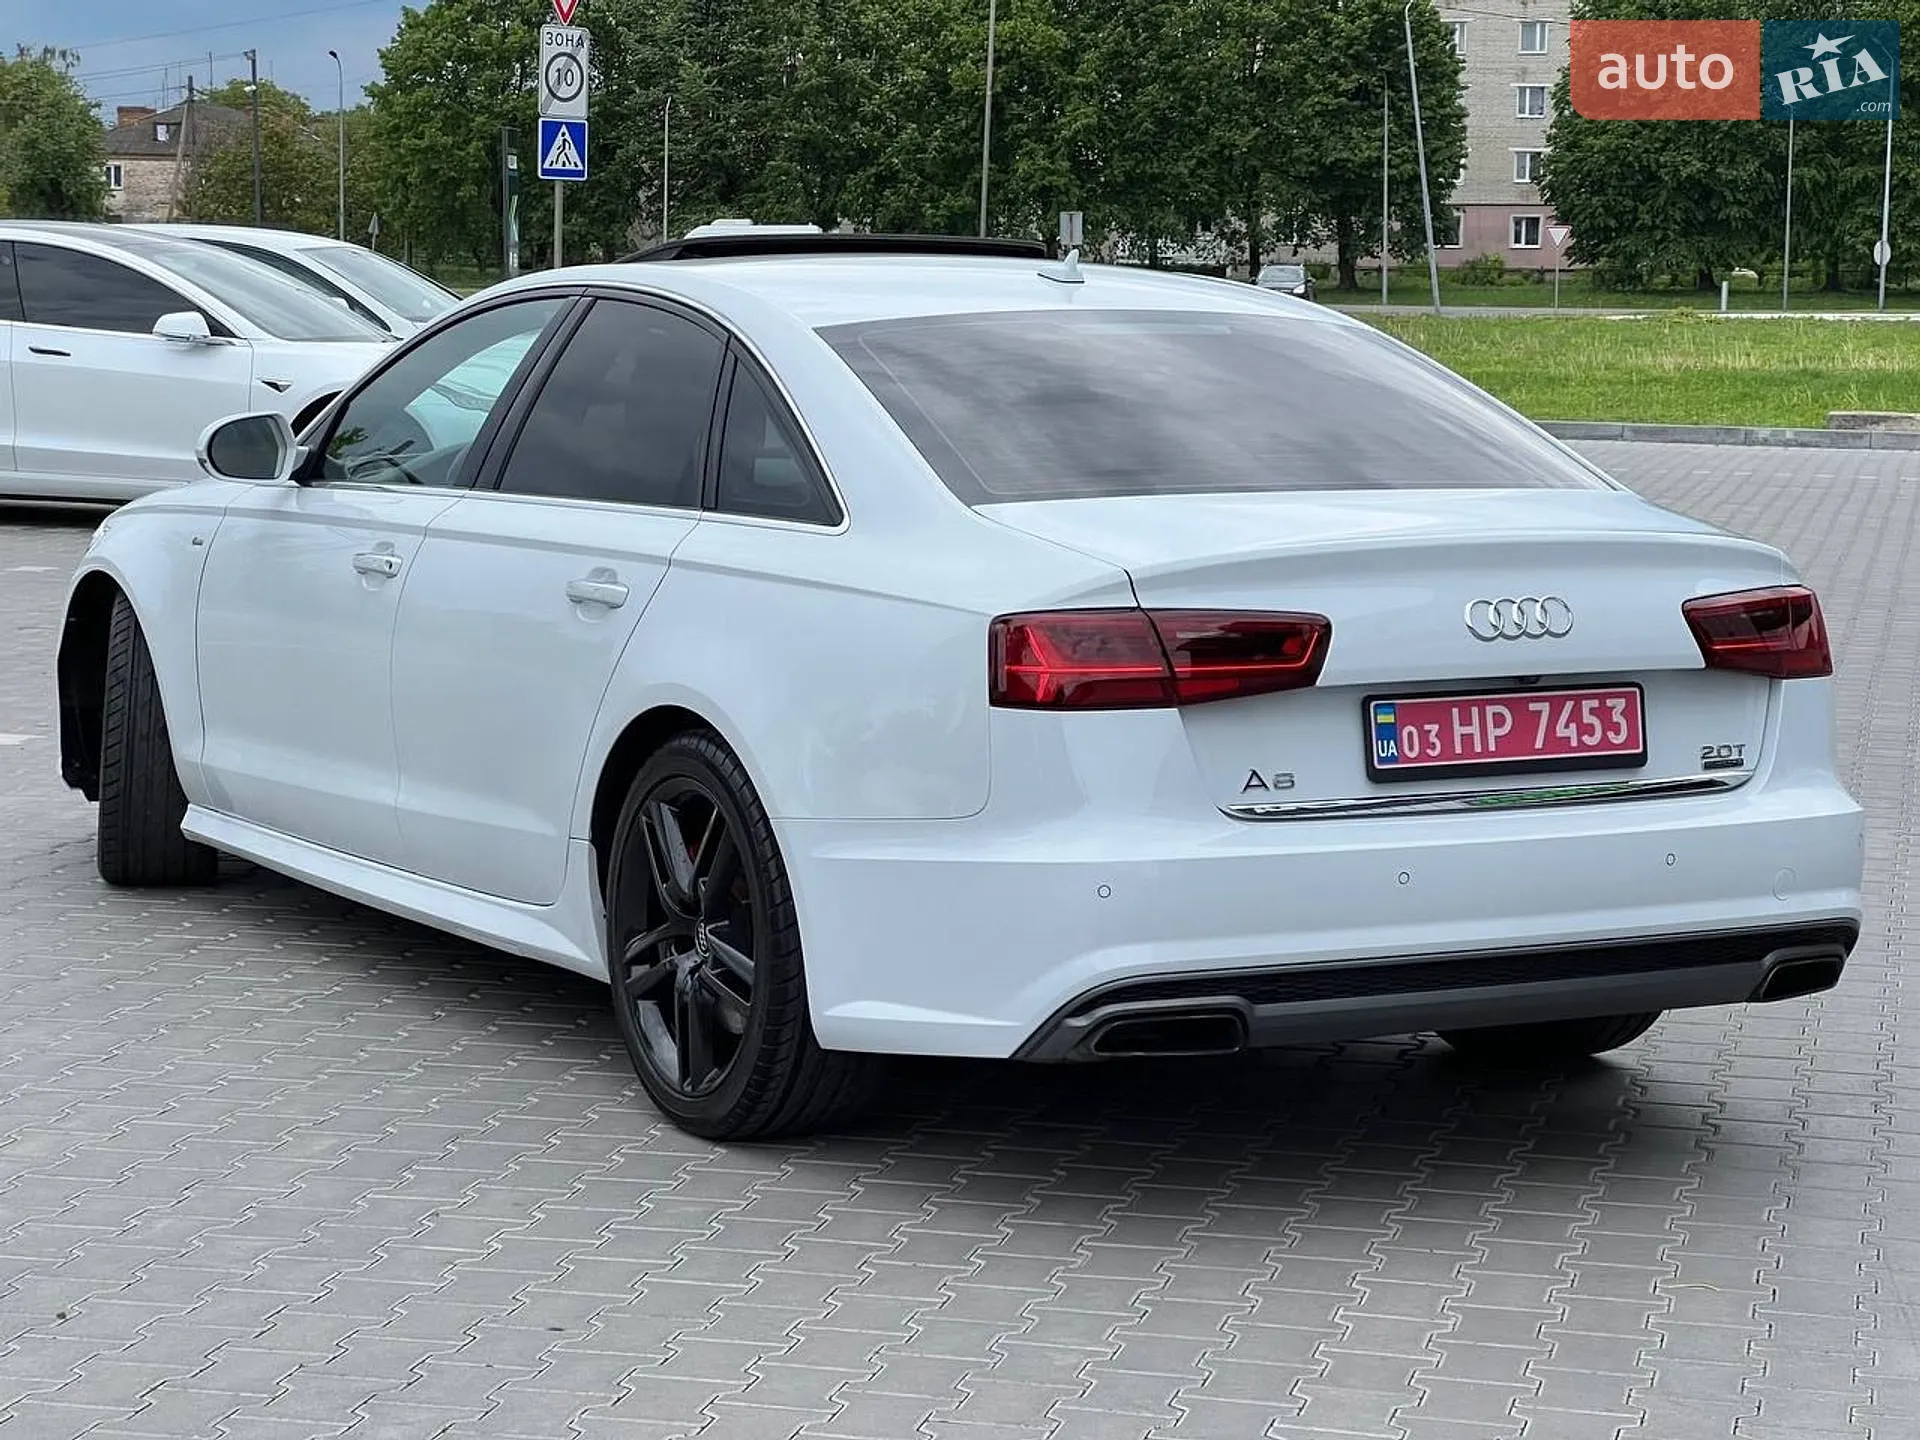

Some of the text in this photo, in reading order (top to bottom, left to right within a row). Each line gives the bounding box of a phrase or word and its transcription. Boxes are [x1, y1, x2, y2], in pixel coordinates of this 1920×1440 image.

[545, 32, 585, 49] ЗОНА
[555, 68, 574, 87] 10
[1402, 698, 1628, 758] 03 HP 7453
[1378, 739, 1398, 757] UA
[1240, 768, 1295, 794] A6
